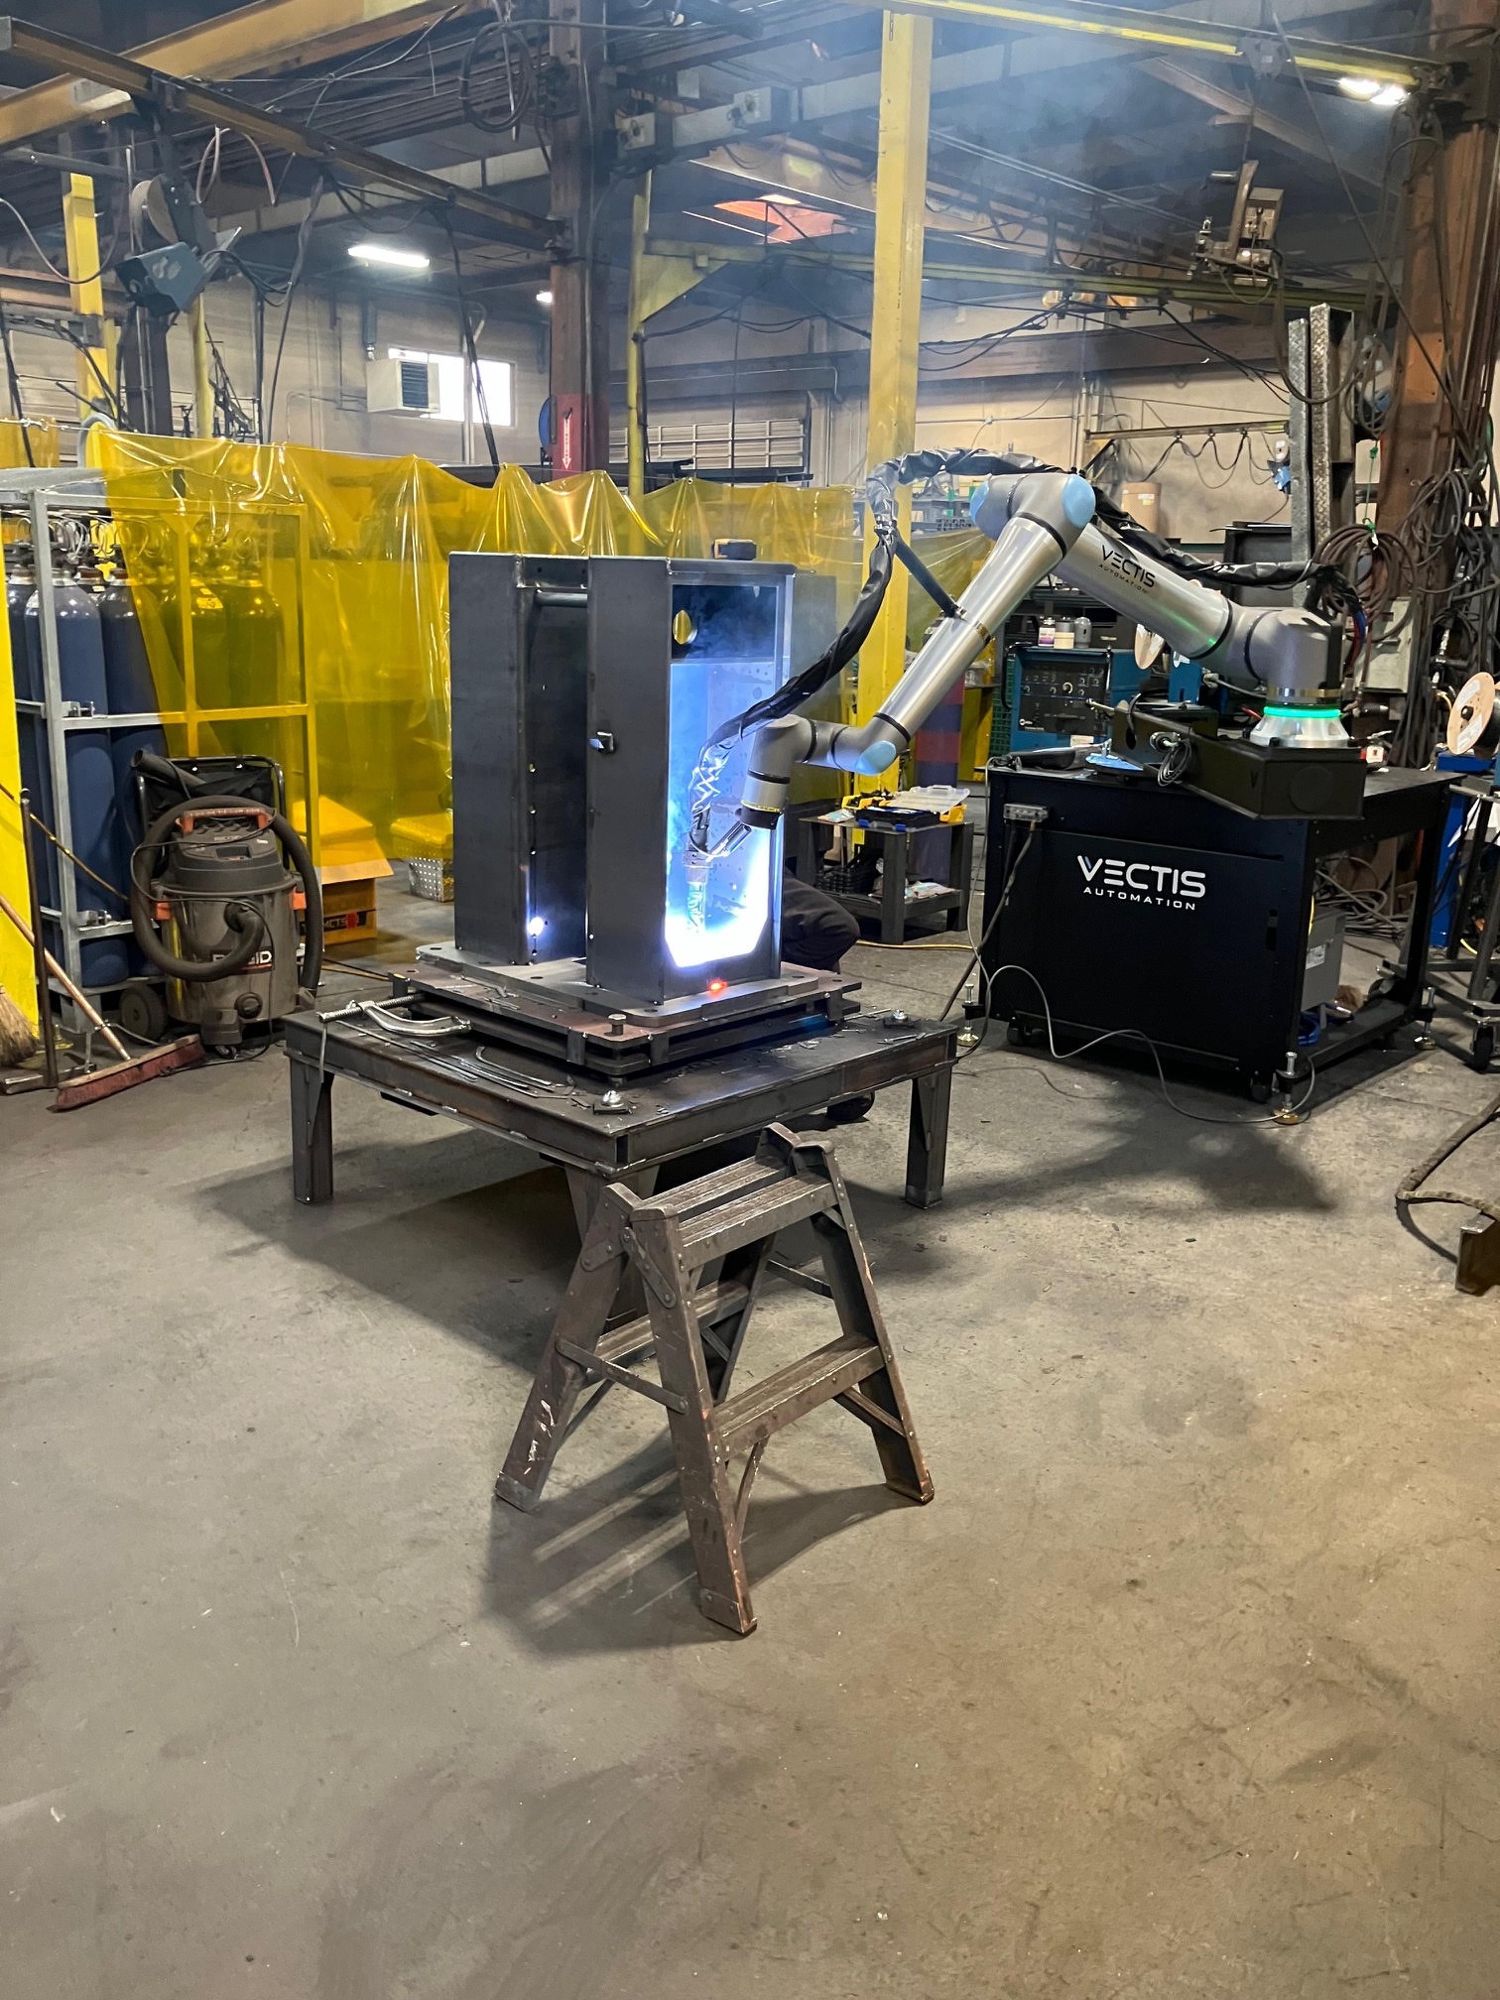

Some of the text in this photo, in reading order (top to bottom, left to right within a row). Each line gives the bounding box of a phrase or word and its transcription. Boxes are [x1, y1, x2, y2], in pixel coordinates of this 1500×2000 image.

[1102, 545, 1156, 588] VECTIS
[1077, 855, 1207, 898] VECTIS
[1083, 886, 1196, 911] AUTOMATION
